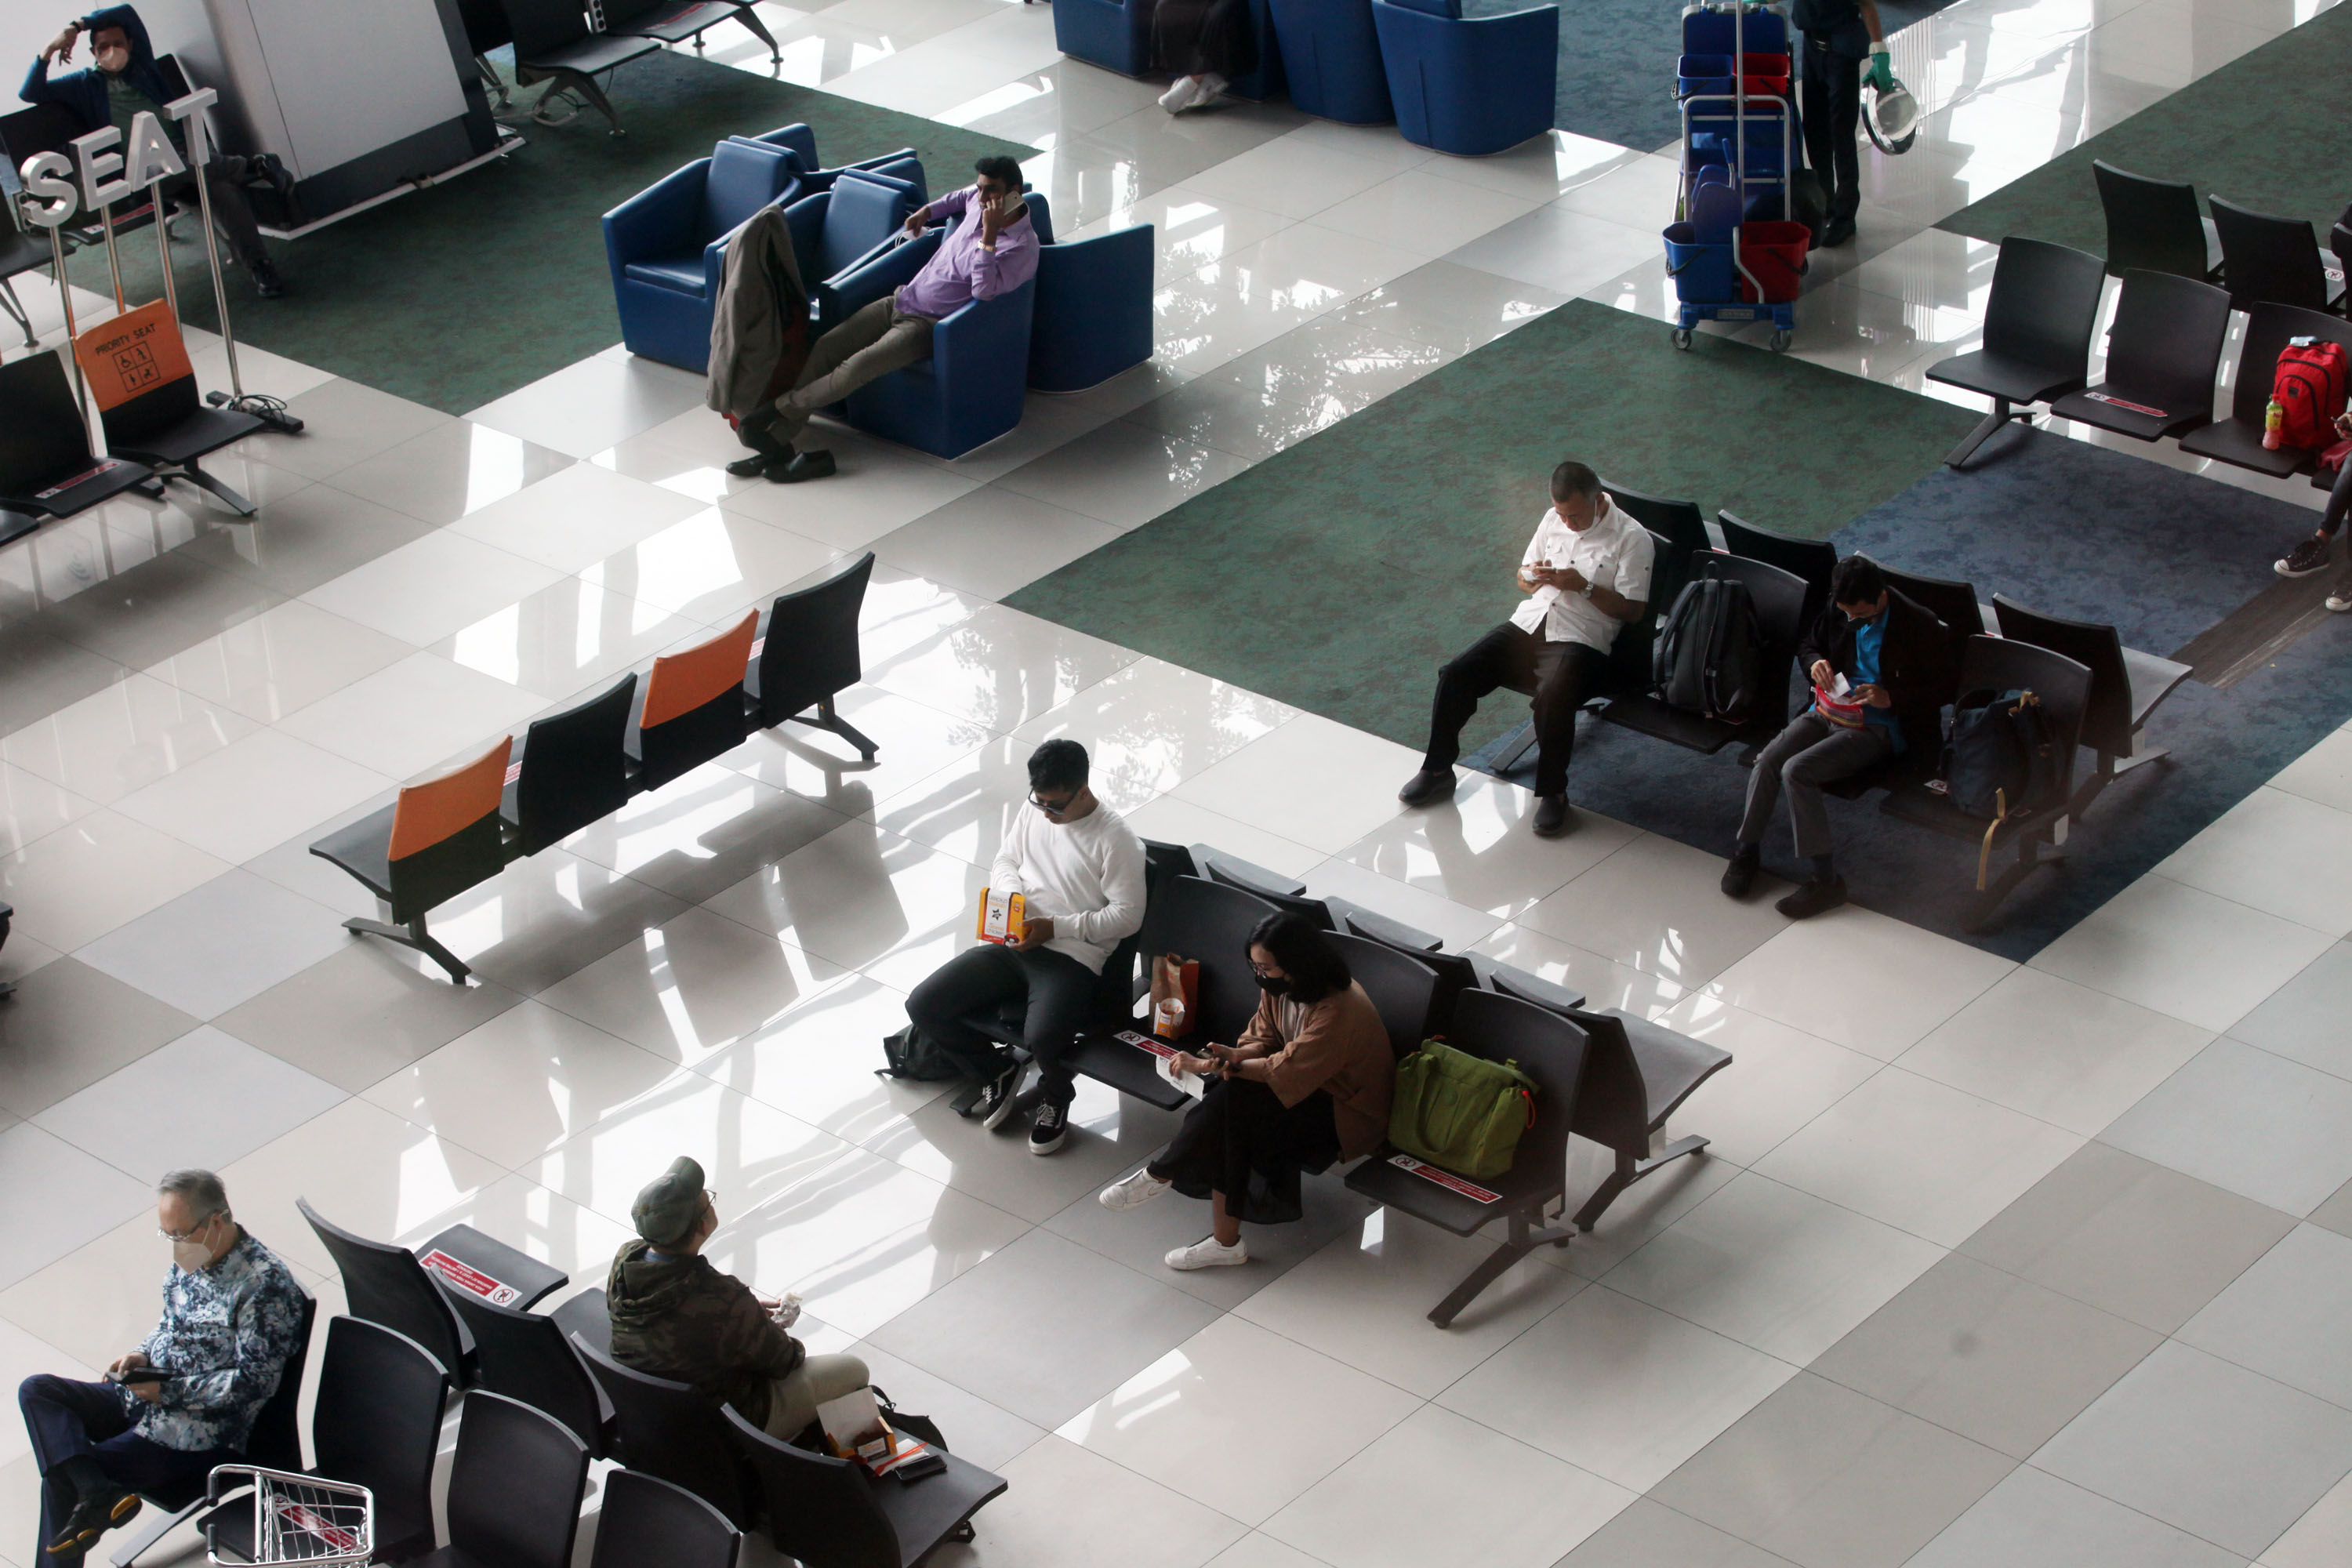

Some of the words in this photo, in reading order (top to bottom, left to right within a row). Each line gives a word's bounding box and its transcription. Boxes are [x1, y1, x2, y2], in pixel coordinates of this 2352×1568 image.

[20, 87, 218, 227] SEAT
[95, 335, 130, 356] PRIORITY
[132, 323, 156, 339] SEAT
